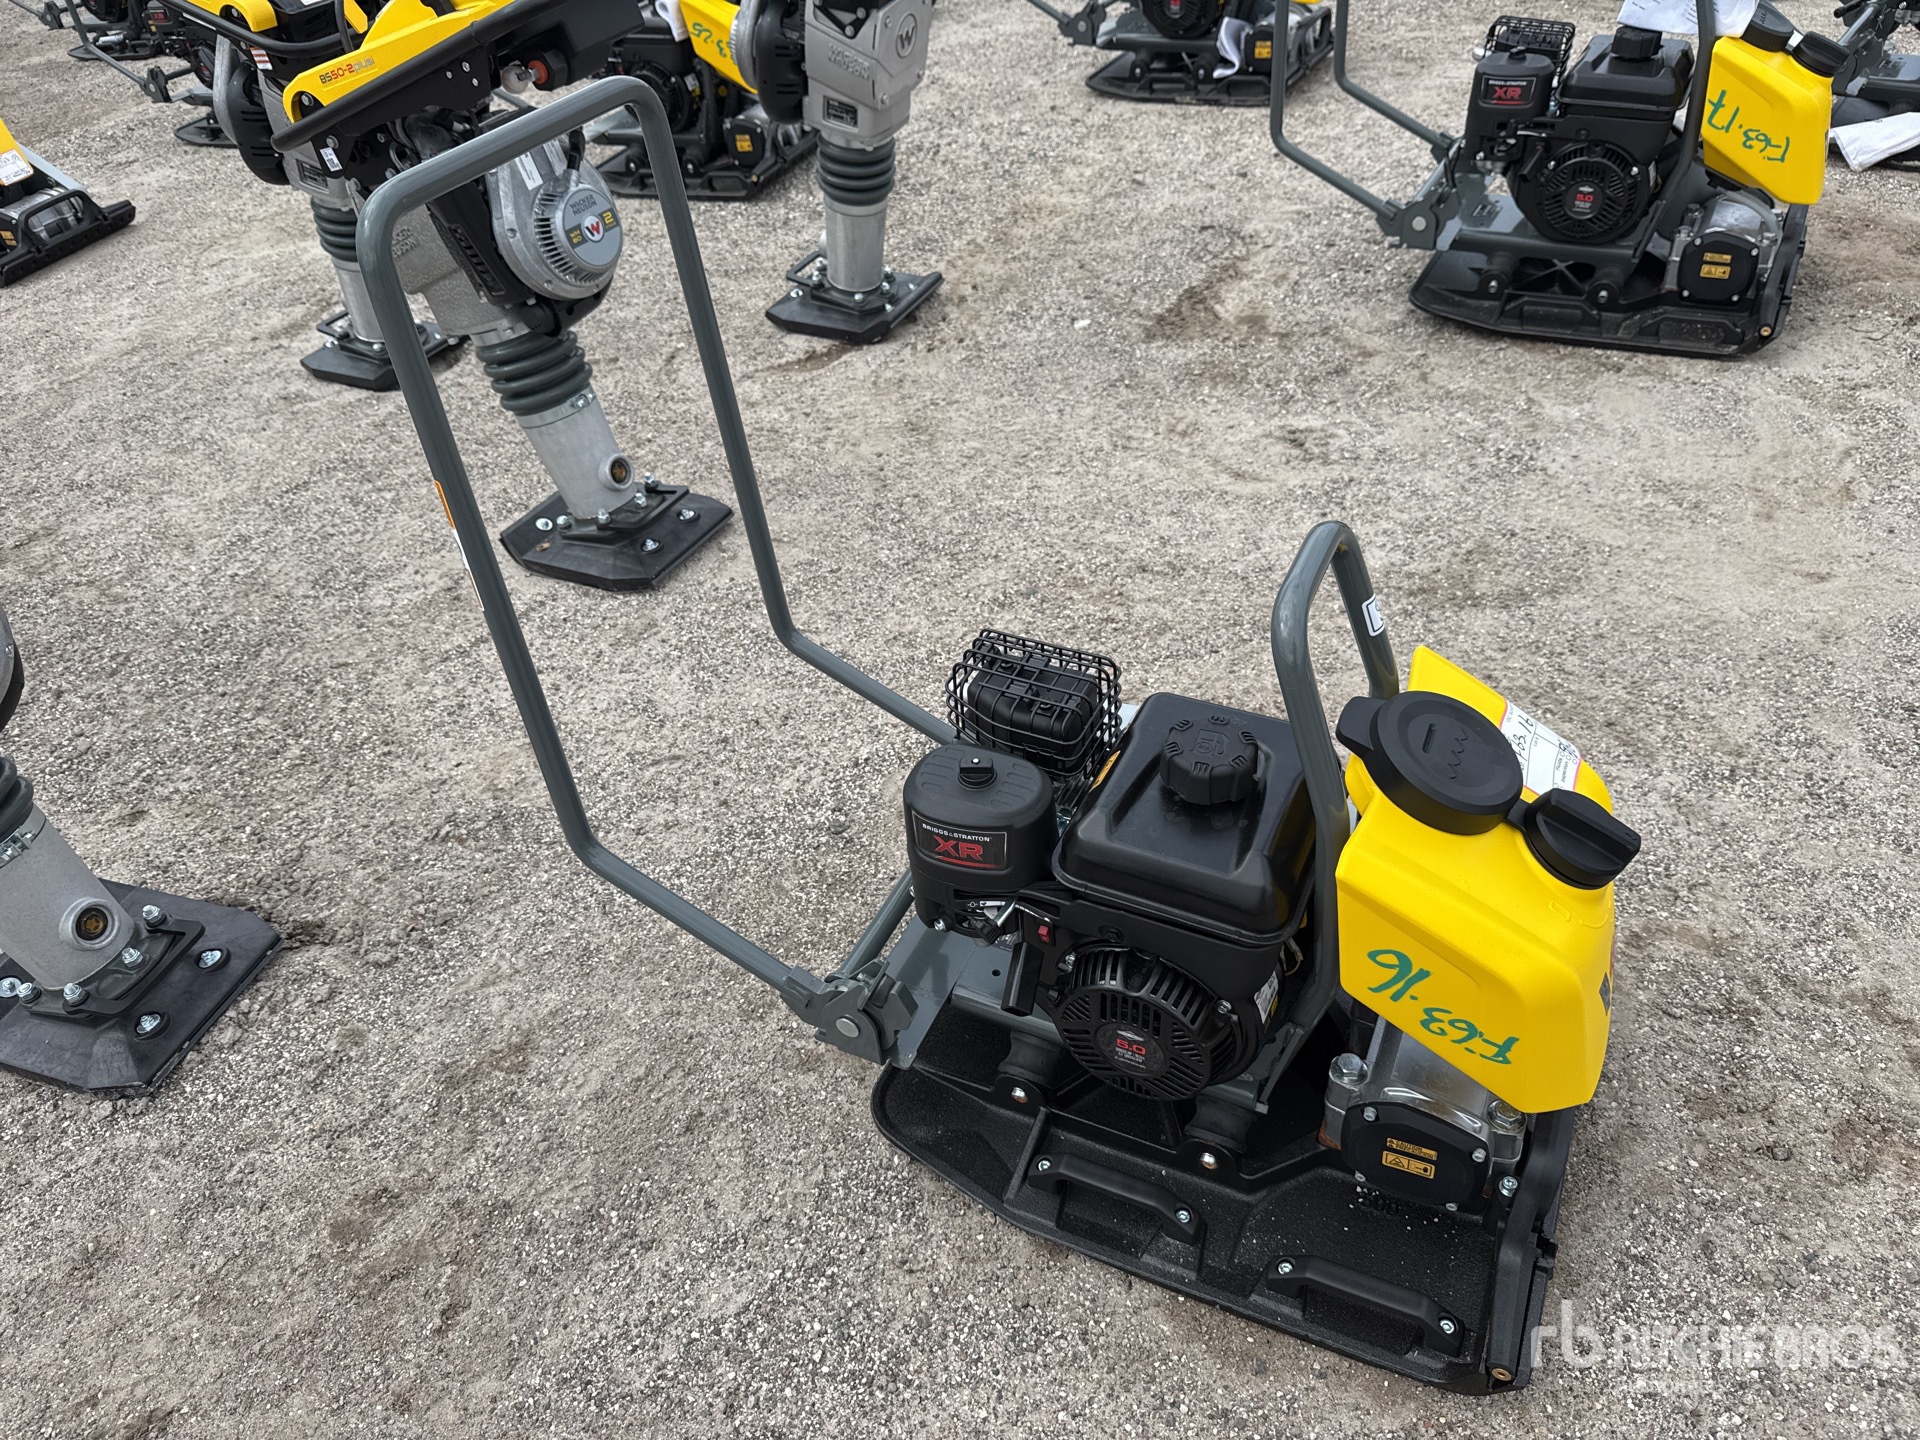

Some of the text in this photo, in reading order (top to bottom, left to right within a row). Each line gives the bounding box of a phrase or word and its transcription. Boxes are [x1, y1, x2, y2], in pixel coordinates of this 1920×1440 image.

[1493, 86, 1522, 99] XR
[569, 194, 595, 209] WACKER
[572, 200, 597, 216] NEUSON
[933, 835, 983, 861] XR
[1116, 1039, 1146, 1055] 5.0
[1395, 1140, 1423, 1152] CAUTION
